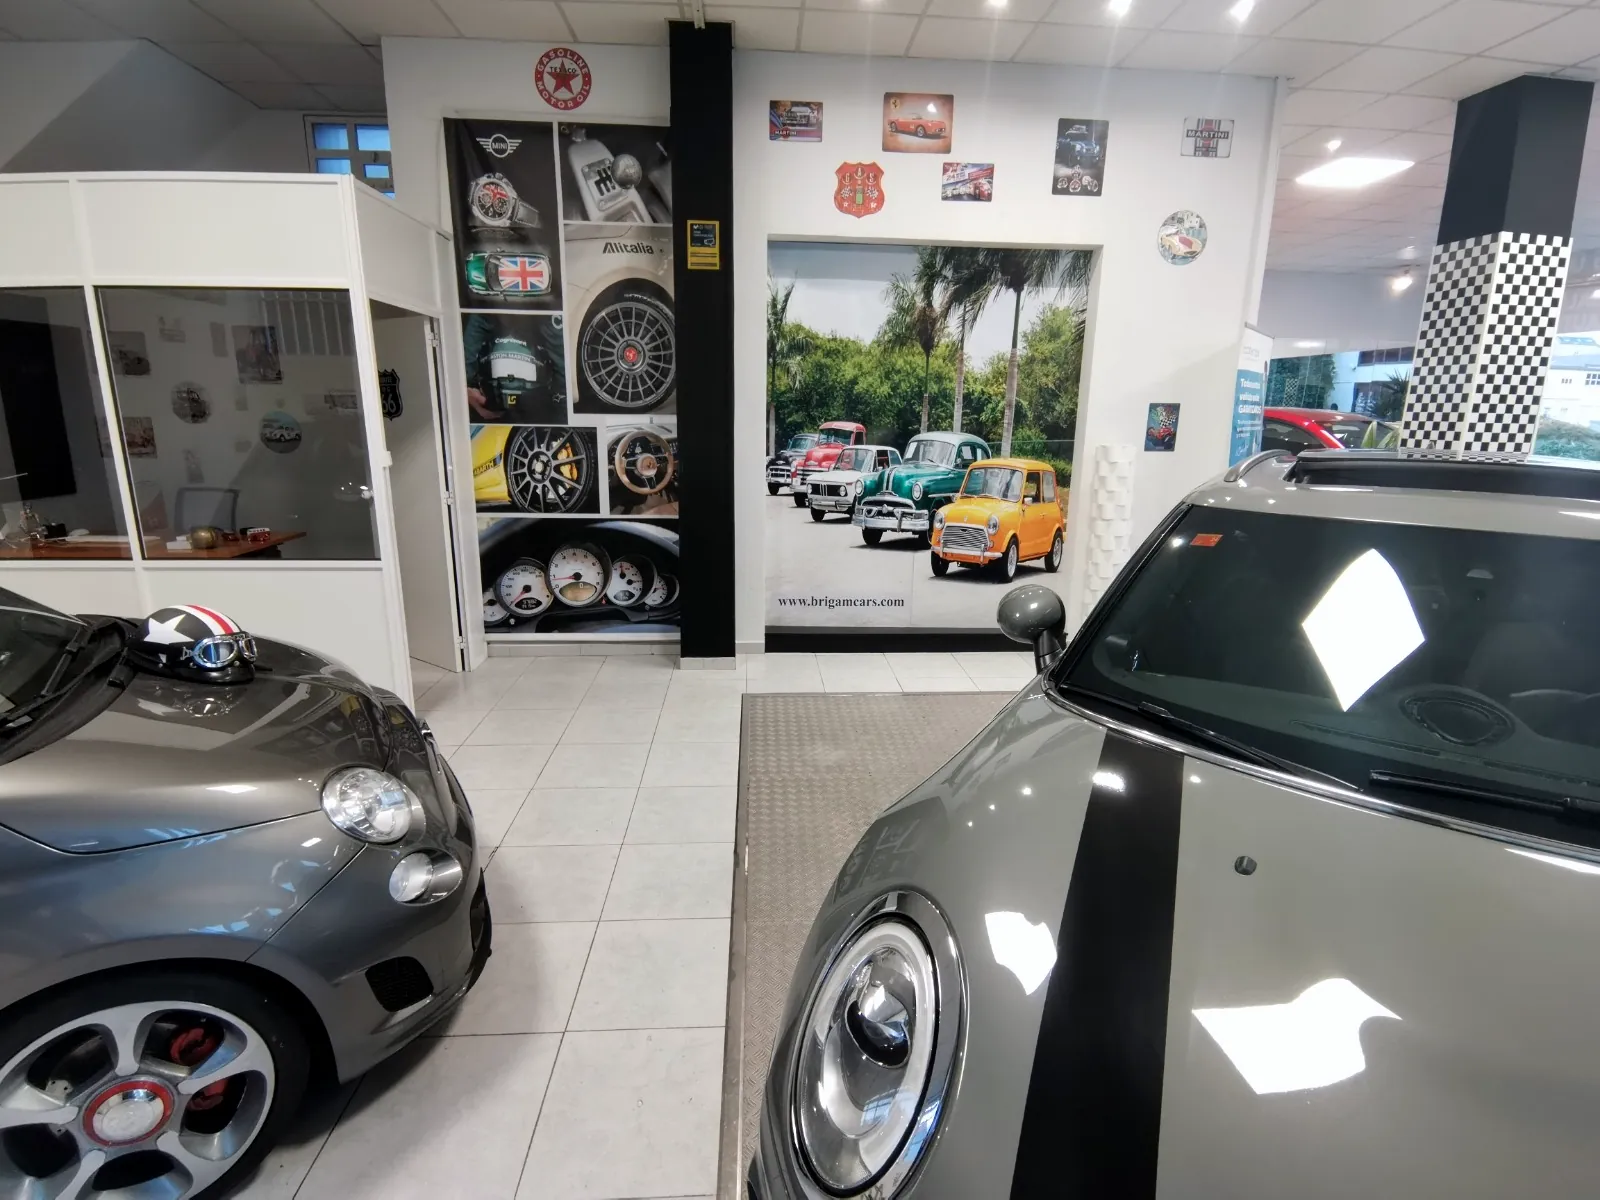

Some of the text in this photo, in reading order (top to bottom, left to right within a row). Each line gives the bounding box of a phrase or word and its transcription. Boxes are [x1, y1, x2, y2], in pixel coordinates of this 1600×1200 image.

[537, 49, 589, 74] GASOLINE
[537, 81, 590, 108] MOTOR OIL
[1187, 130, 1229, 138] MARTINI
[492, 142, 508, 150] MINI
[845, 167, 875, 183] GAS
[602, 242, 655, 254] Alitalia
[778, 596, 905, 609] www.brigamcars.com
